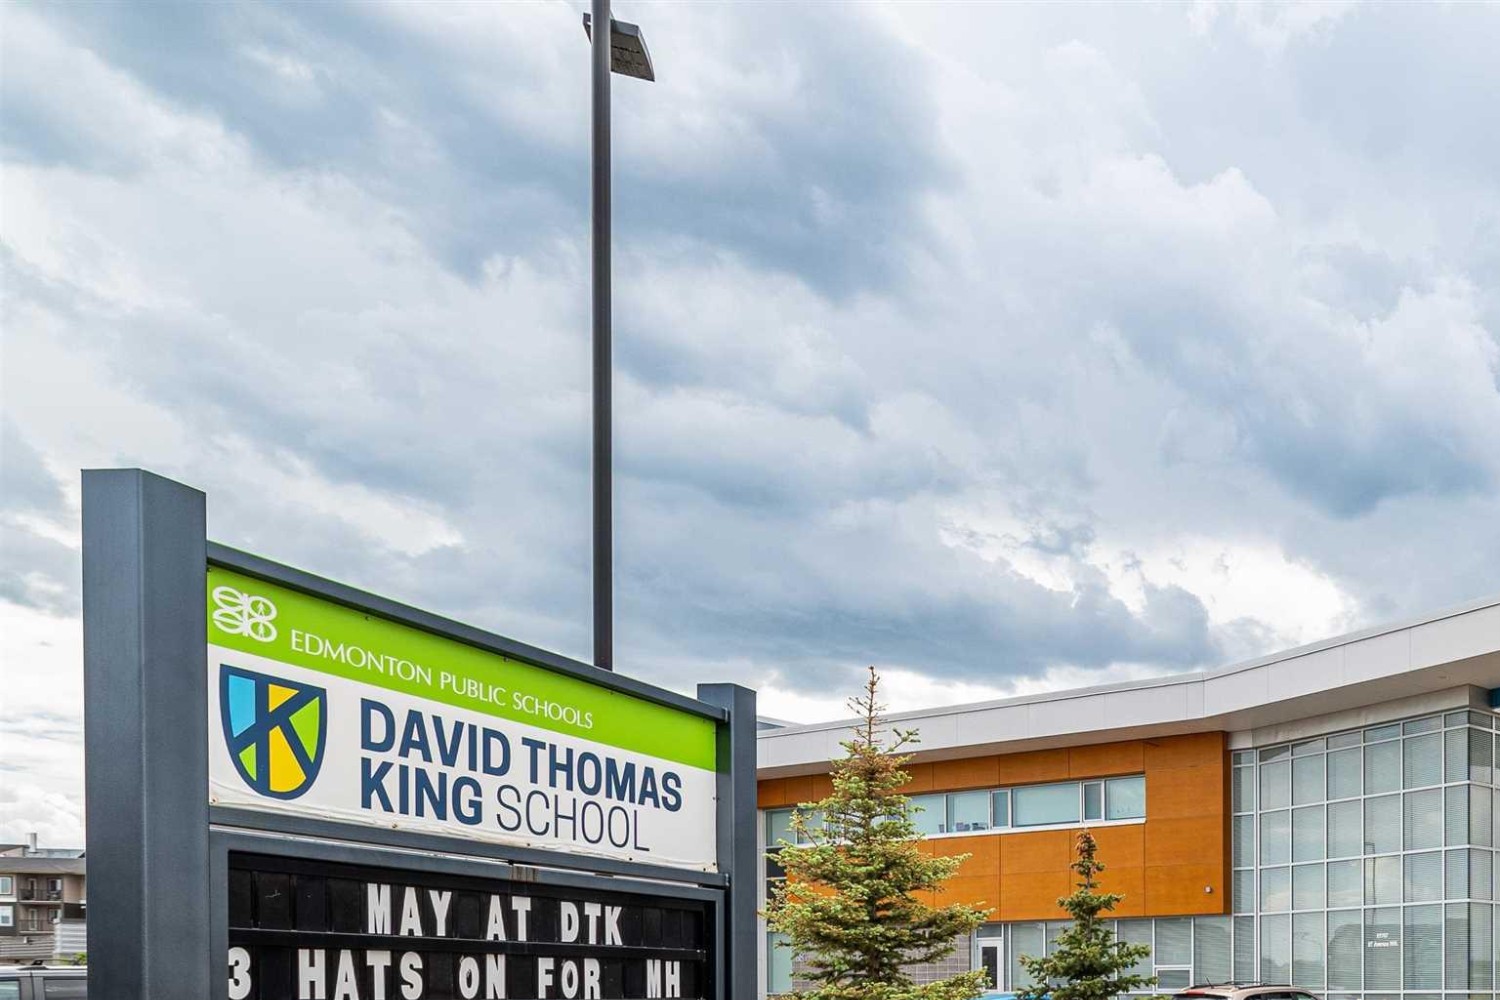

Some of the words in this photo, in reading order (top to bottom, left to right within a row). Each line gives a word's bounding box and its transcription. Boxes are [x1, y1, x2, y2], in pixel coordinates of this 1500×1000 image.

[291, 629, 432, 688] EDMONTON
[440, 670, 507, 707] PUBLIC
[512, 691, 594, 730] SCHOOLS
[360, 697, 511, 777] DAVID
[521, 736, 682, 813] THOMAS
[360, 756, 483, 825] KING
[496, 784, 650, 852] SCHOOL
[367, 883, 453, 937] MAY
[485, 894, 532, 941] AT
[560, 901, 623, 947] DTK
[228, 946, 252, 1000] 3
[458, 953, 507, 1000] ON
[537, 957, 602, 999] FOR
[645, 960, 681, 999] MH
